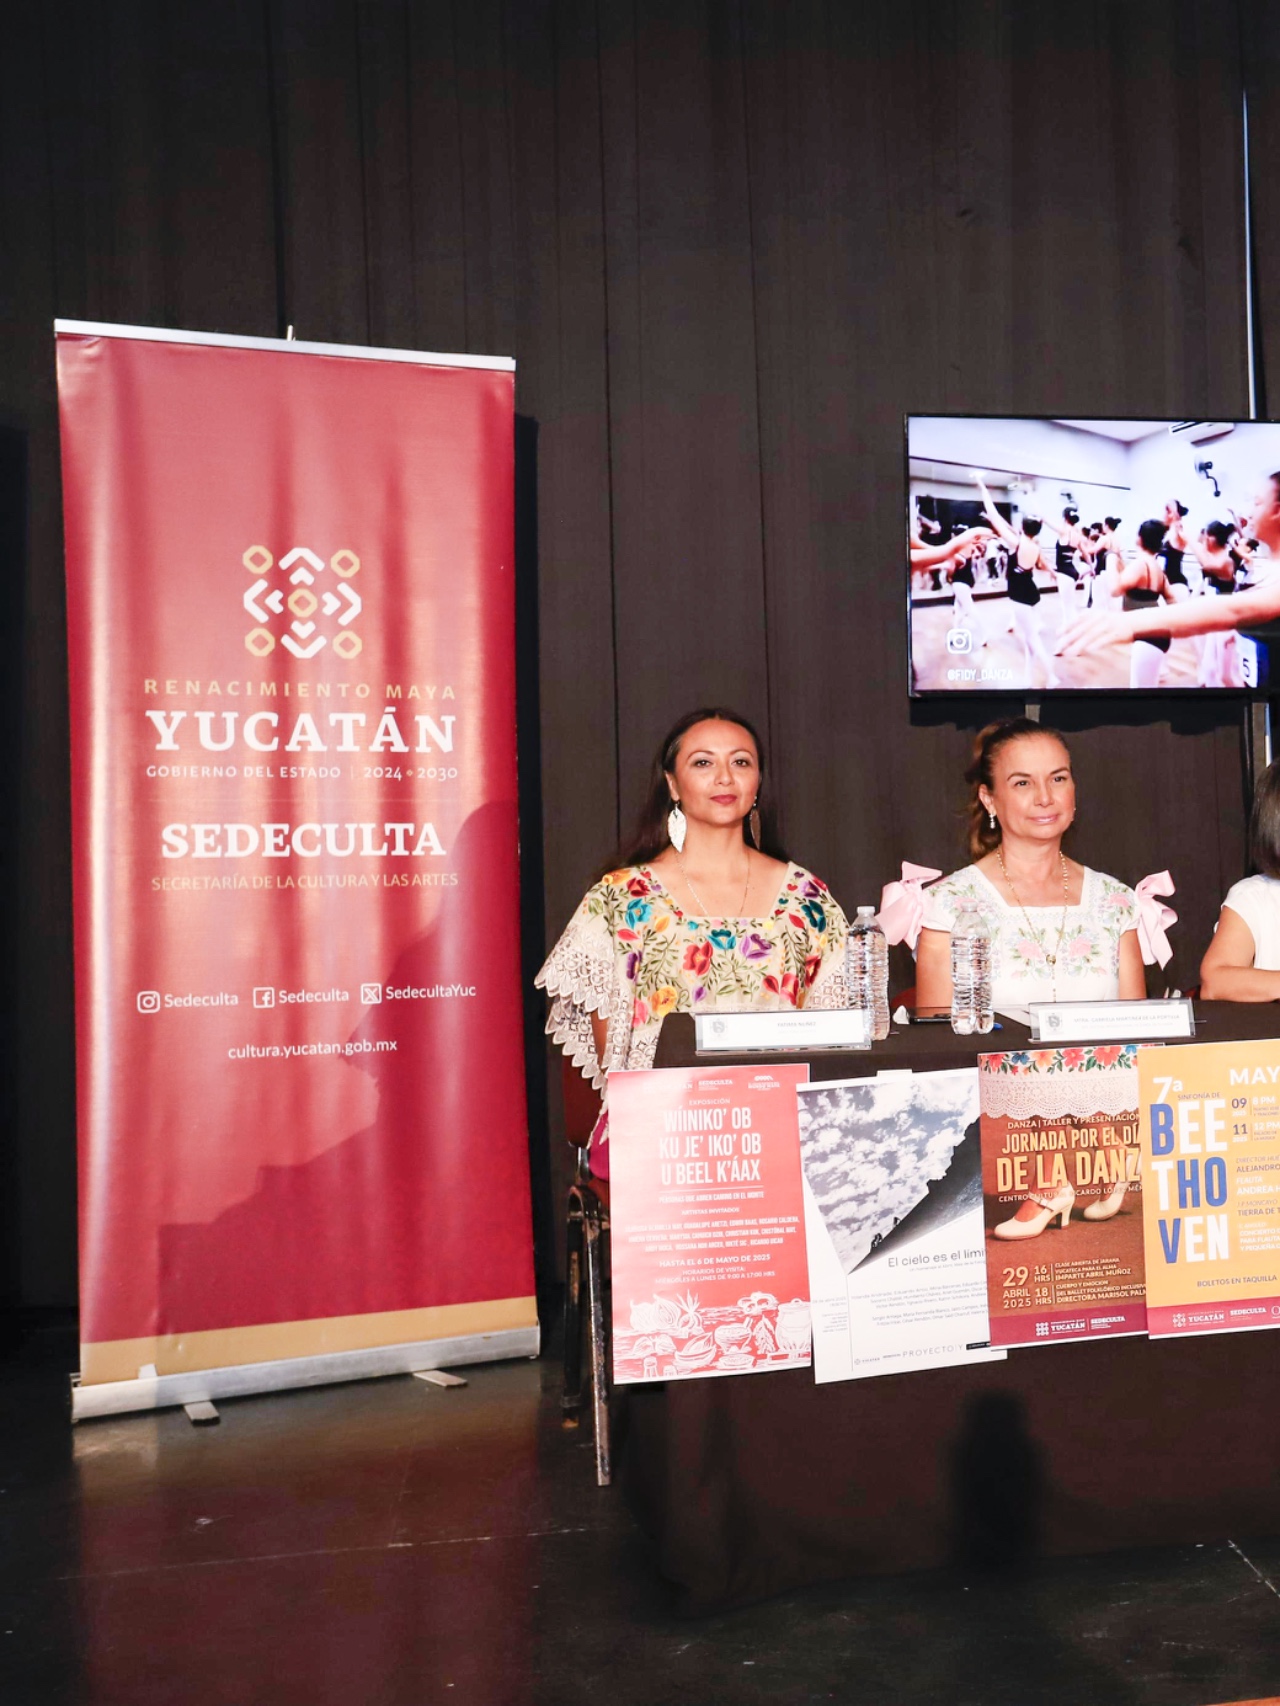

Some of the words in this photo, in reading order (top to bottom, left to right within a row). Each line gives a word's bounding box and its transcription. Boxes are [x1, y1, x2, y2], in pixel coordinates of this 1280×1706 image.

[145, 680, 371, 697] RENACIMIENTO
[386, 686, 455, 700] MAYA
[146, 707, 455, 752] YUCATÁN
[147, 766, 238, 778] GOBIERNO
[244, 767, 274, 778] DEL
[280, 767, 341, 778] ESTADO
[364, 767, 402, 780] 2024
[418, 768, 458, 781] 2030
[162, 823, 446, 858] SEDECULTA
[152, 874, 251, 890] SECRETARÍA
[253, 876, 273, 889] DE
[277, 875, 295, 888] LA
[298, 875, 367, 888] CULTURA
[371, 874, 379, 886] Y
[383, 874, 409, 887] LAS
[411, 874, 458, 886] ARTES
[165, 992, 238, 1008] Sedeculta
[279, 989, 349, 1004] Sedeculta
[386, 984, 475, 1000] SedecultaYuc
[228, 1039, 397, 1059] cultura.yucatan.gob.mx
[732, 1108, 751, 1129] OB
[1150, 1100, 1227, 1156] BEE
[659, 1137, 679, 1158] KU
[742, 1134, 761, 1154] OB
[1002, 1131, 1067, 1153] JORNADA
[1072, 1128, 1098, 1148] POR
[1103, 1127, 1119, 1145] EL
[662, 1164, 671, 1185] U
[677, 1162, 713, 1184] BEEL
[997, 1157, 1028, 1192] DE
[1036, 1153, 1068, 1188] LA
[1151, 1157, 1227, 1210] THO
[1237, 1186, 1273, 1195] ANDREA
[1158, 1214, 1229, 1264] VEN
[888, 1257, 898, 1268] El
[902, 1255, 930, 1266] cielo
[933, 1254, 947, 1262] es
[951, 1251, 960, 1260] el
[1002, 1266, 1028, 1287] 29
[1034, 1266, 1046, 1275] 16
[1034, 1275, 1050, 1283] HRS
[1056, 1273, 1084, 1281] IMPARTE
[1106, 1268, 1131, 1276] MUÑOZ
[1197, 1279, 1229, 1287] BOLETOS
[1243, 1275, 1277, 1283] TAQUILLA
[1003, 1289, 1030, 1298] ABRIL
[1035, 1288, 1048, 1296] 18
[1004, 1299, 1031, 1308] 2025
[1036, 1297, 1051, 1305] HRS
[903, 1345, 954, 1358] PROYECTO
